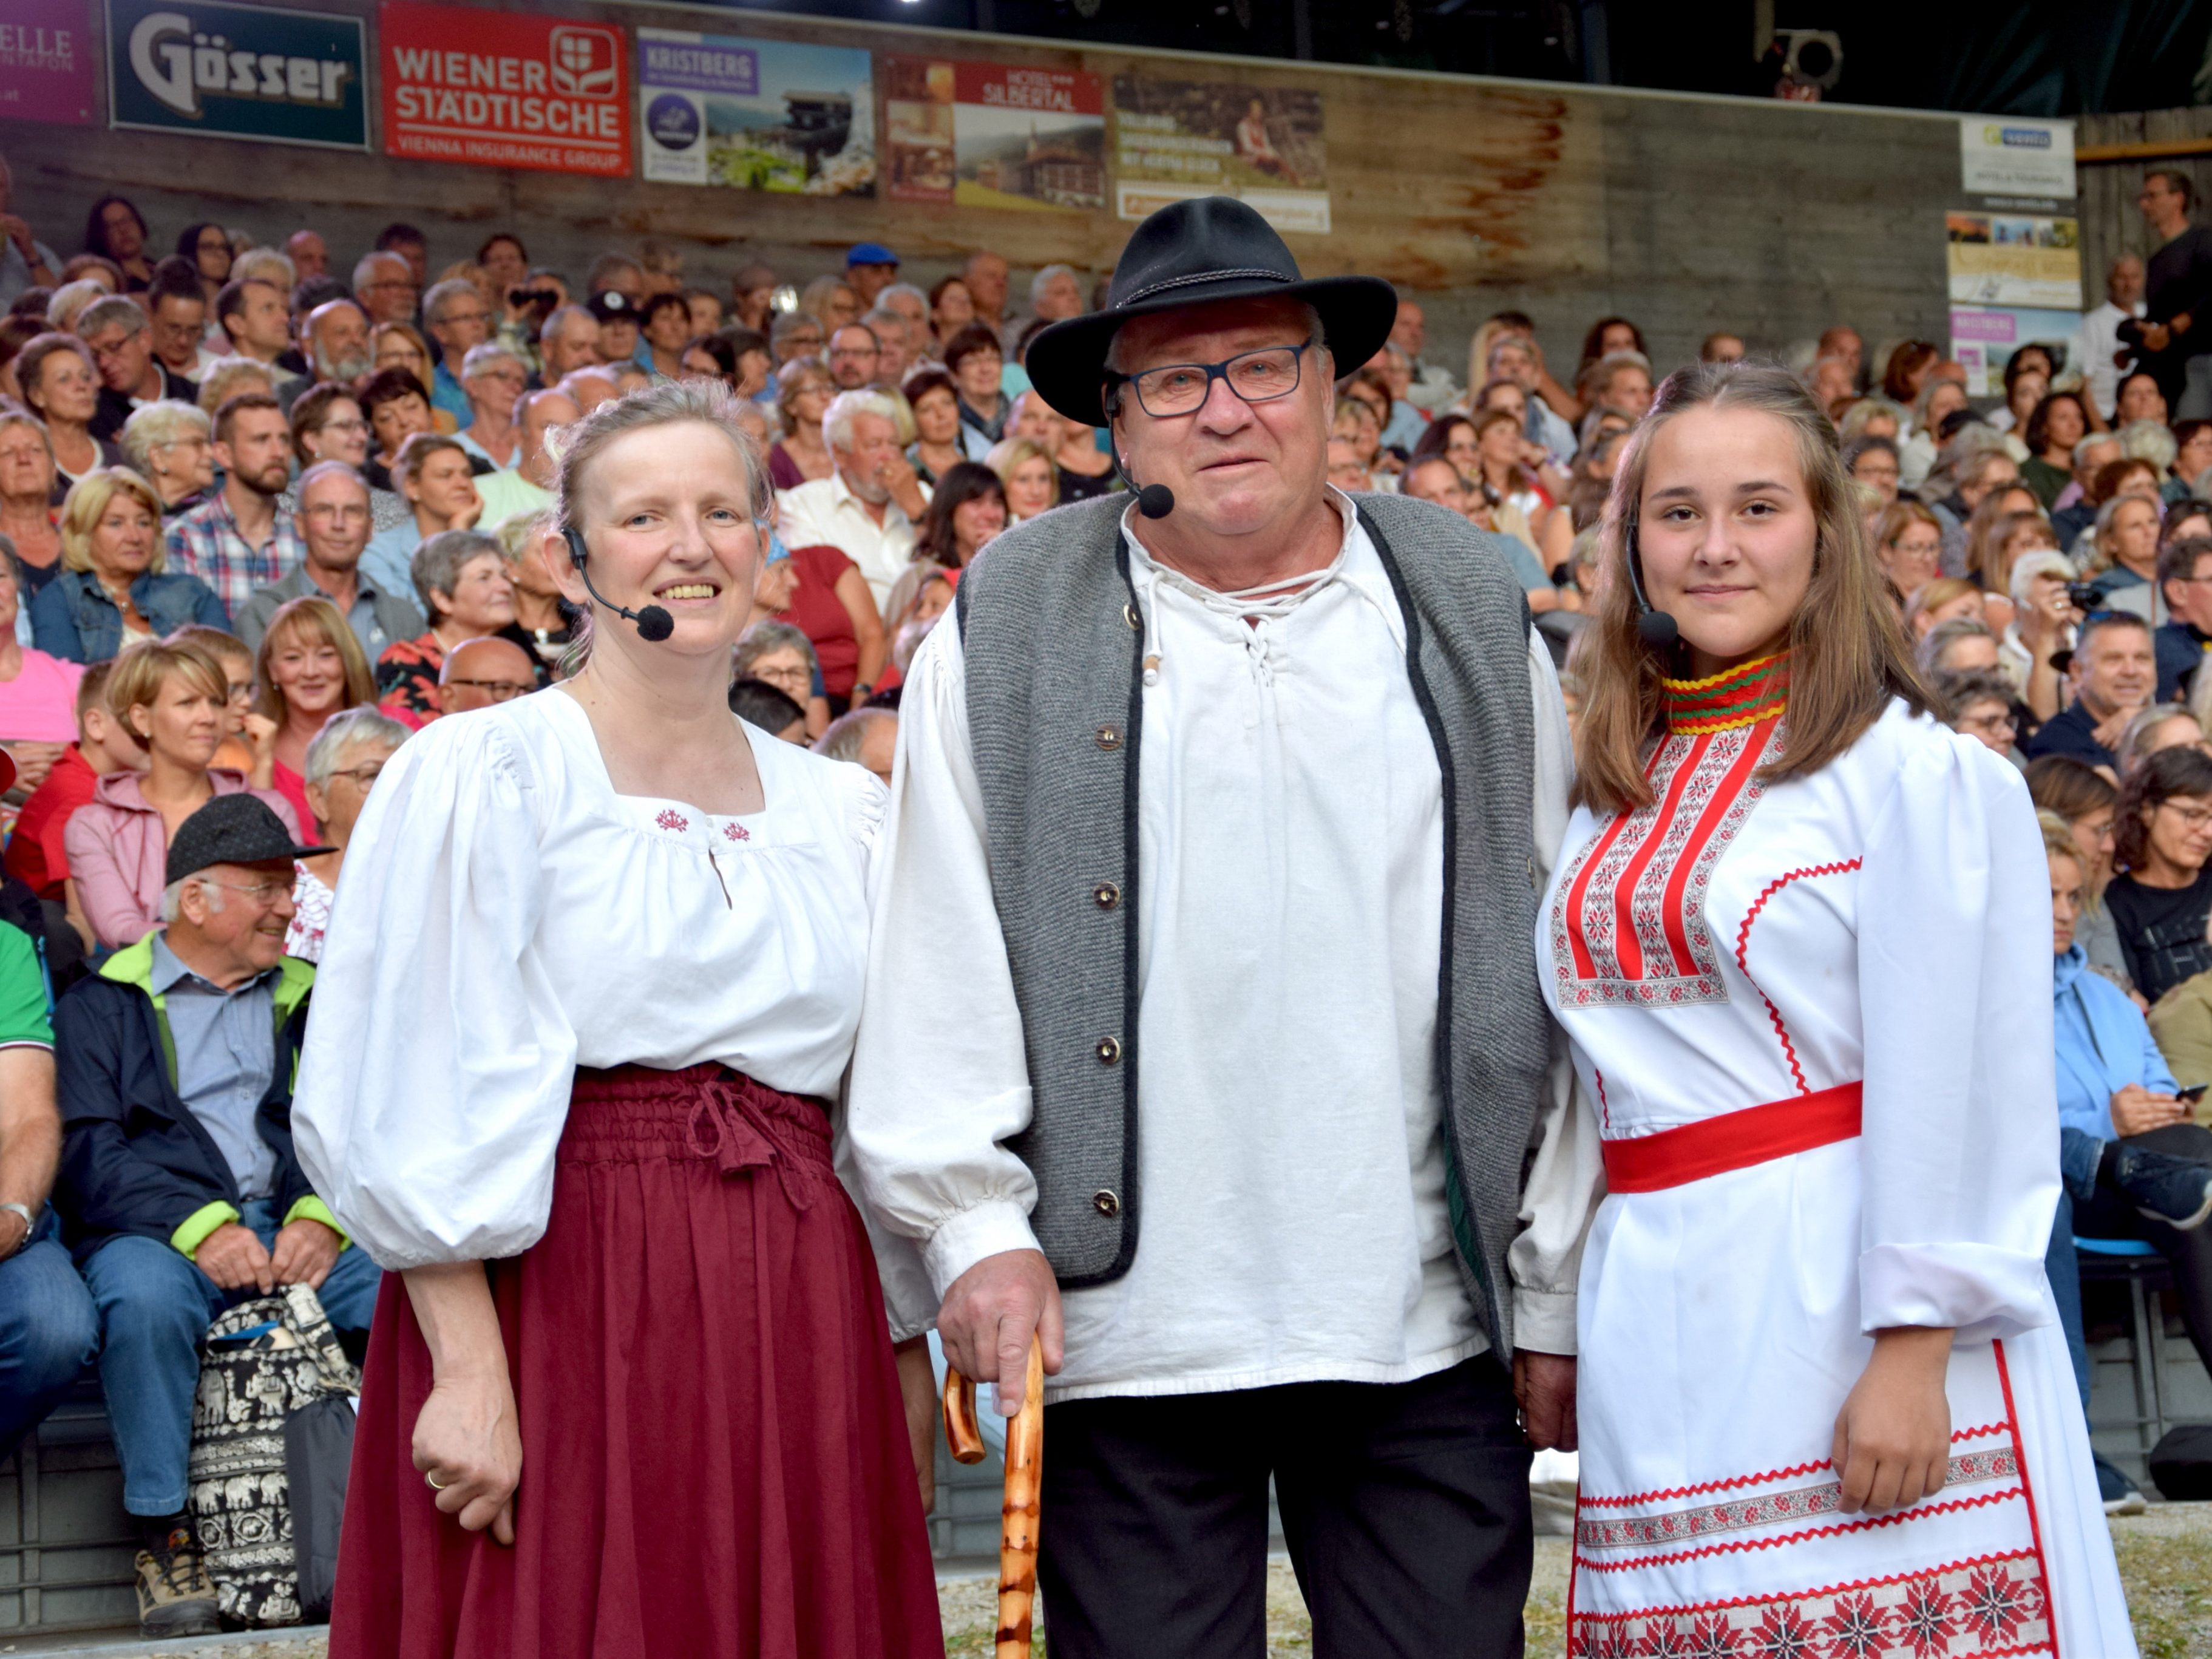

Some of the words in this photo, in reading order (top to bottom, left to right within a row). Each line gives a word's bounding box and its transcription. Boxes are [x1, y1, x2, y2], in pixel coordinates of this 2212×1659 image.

[129, 12, 348, 115] Gösser
[393, 46, 548, 93] WIENER
[646, 46, 751, 78] KRISTBERG
[396, 84, 620, 138] STÄDTISCHE
[982, 83, 1076, 110] SILBERTAL
[399, 135, 463, 156] VIENNA
[466, 140, 561, 166] INSURANCE
[564, 149, 621, 169] GROUP
